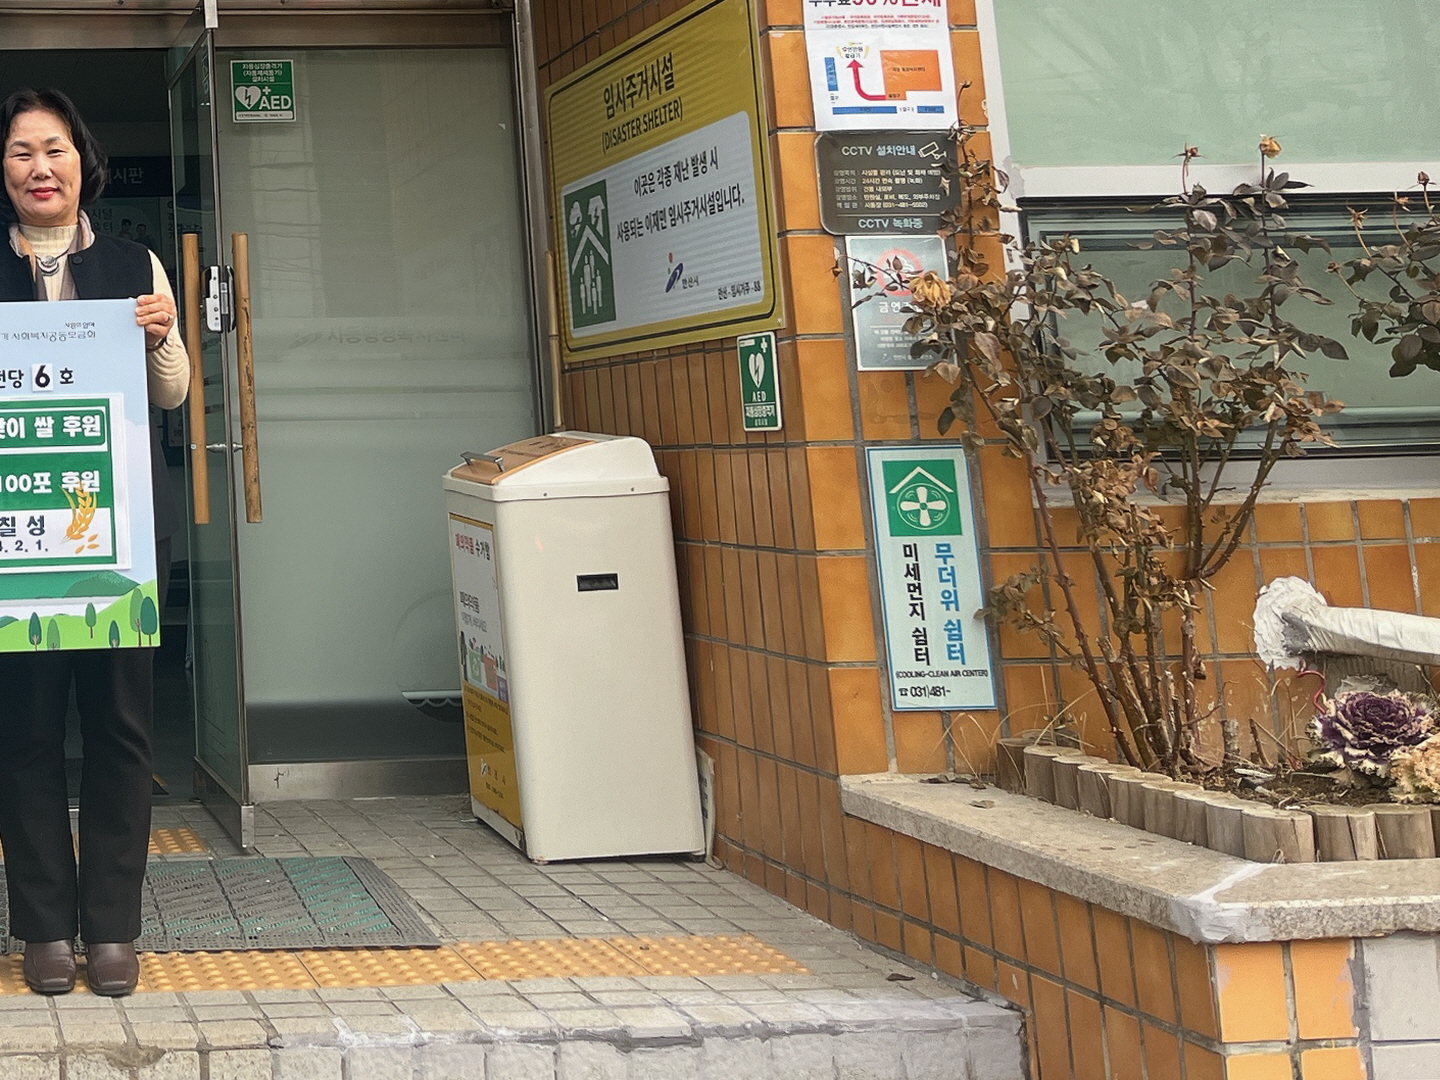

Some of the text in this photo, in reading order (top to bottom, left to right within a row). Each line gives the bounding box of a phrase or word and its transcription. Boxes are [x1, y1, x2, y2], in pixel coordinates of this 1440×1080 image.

[604, 52, 675, 120] 임시주거시설
[259, 96, 292, 109] AED
[602, 96, 683, 155] (DISASTER SHELTER)
[842, 145, 916, 156] CCTV 설치안내
[634, 146, 718, 197] 이곳은 각종 재난 발생 시
[617, 183, 745, 243] 사용되는 이재민 임시주거시설입니다.
[858, 219, 889, 229] CCTV
[35, 365, 51, 388] 6
[60, 367, 74, 385] 호
[752, 391, 767, 402] AED
[34, 416, 55, 438] 쌀
[63, 414, 101, 438] 후원
[61, 470, 101, 493] 후원
[903, 542, 931, 666] 미세먼지 쉼터
[935, 542, 966, 666] 무더위 쉼터
